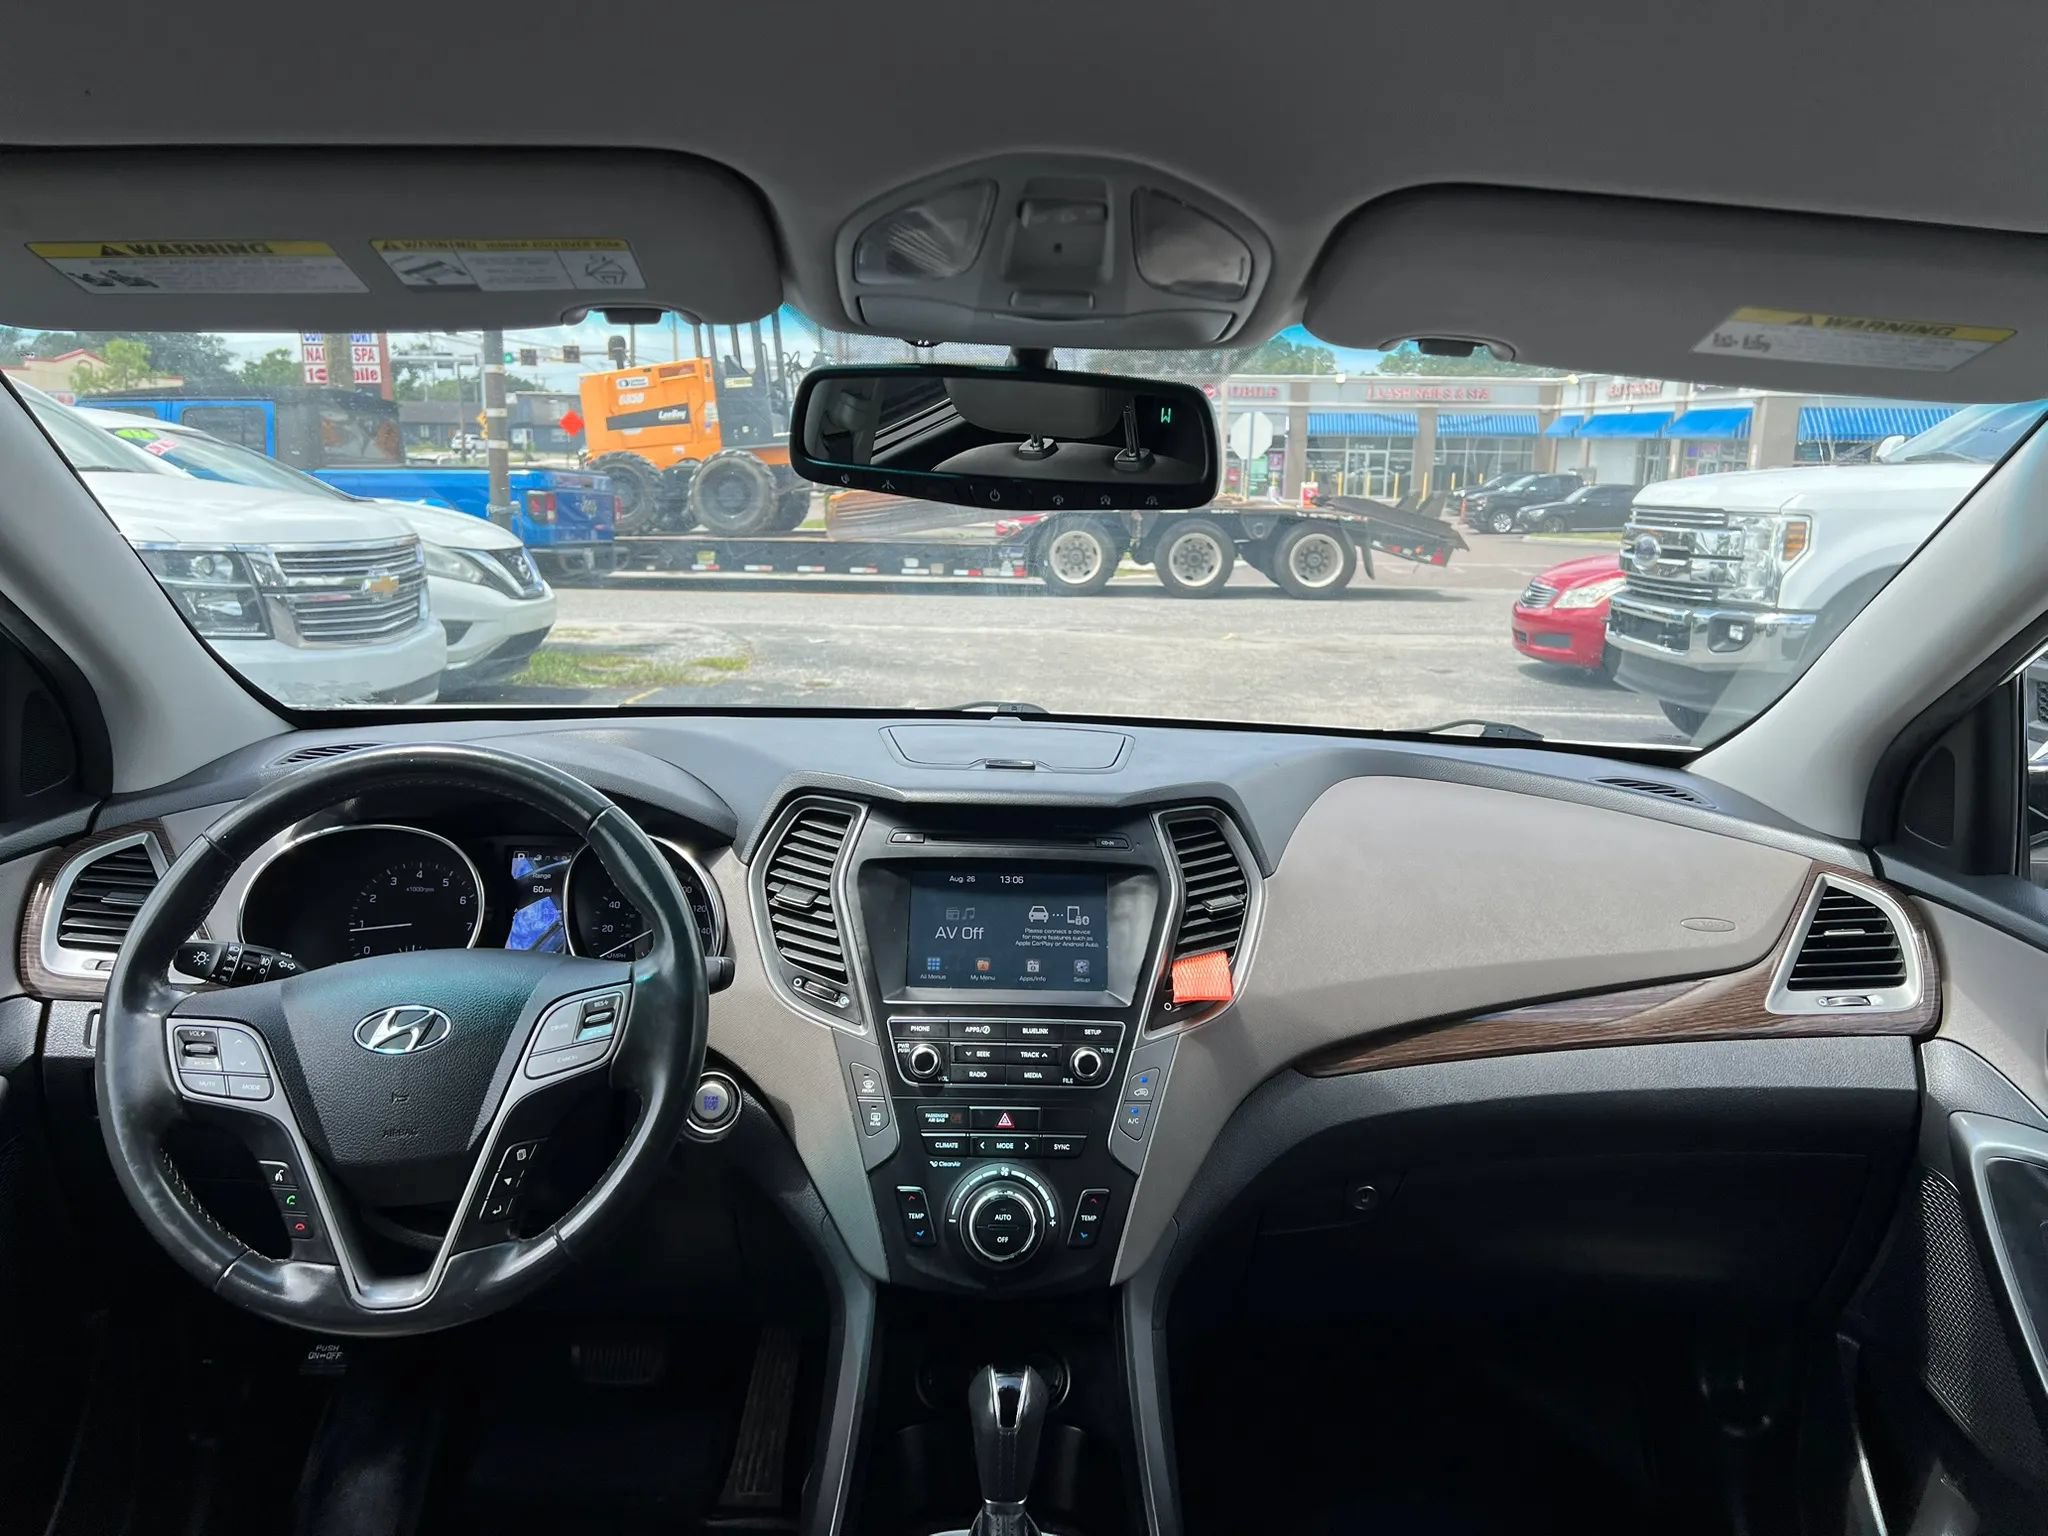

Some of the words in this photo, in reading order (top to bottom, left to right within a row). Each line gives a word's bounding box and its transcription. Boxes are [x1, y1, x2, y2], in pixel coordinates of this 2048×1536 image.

[125, 242, 273, 256] WARNING
[1823, 316, 1957, 337] WARNING
[354, 348, 375, 361] SPA
[1160, 407, 1172, 423] W
[416, 870, 423, 878] 4
[390, 877, 398, 886] 3
[442, 878, 449, 887] 5
[949, 875, 963, 884] Aug
[966, 875, 976, 883] 26
[1000, 875, 1024, 884] 13:06
[533, 885, 544, 893] 60
[369, 894, 377, 903] 2
[459, 896, 467, 905] 6
[608, 901, 620, 909] 40
[466, 922, 473, 931] 7
[601, 924, 614, 933] 20
[935, 926, 958, 939] AV
[962, 926, 984, 940] Off
[363, 946, 371, 955] 0
[994, 1213, 1012, 1221] AUTO
